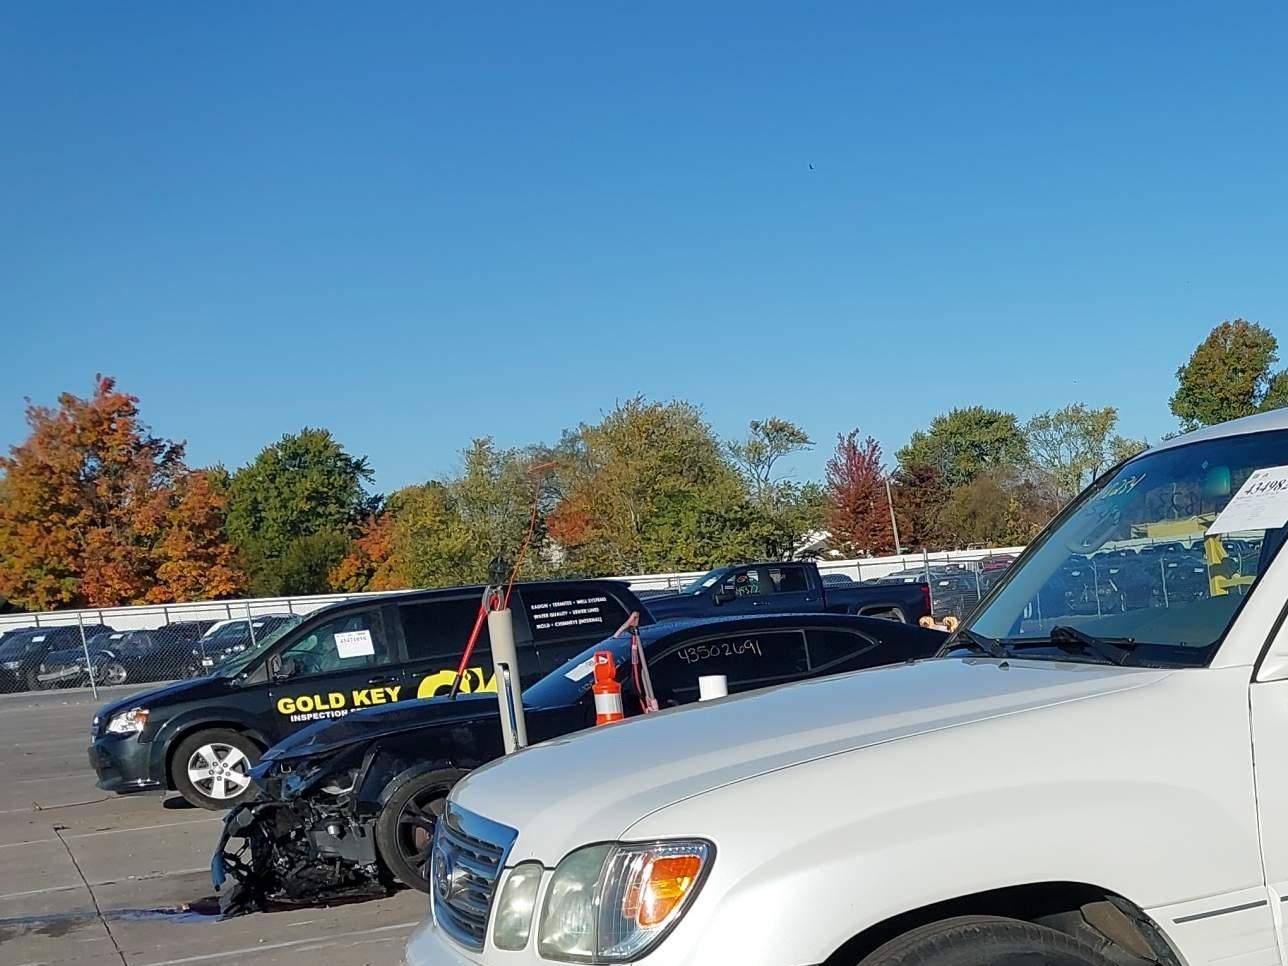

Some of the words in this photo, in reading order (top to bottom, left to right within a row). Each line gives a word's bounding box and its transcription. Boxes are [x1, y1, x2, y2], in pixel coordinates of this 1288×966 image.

[678, 639, 762, 664] 43502691
[277, 692, 346, 714] GOLD
[352, 686, 401, 706] KEY
[290, 709, 348, 722] INSPECTION
